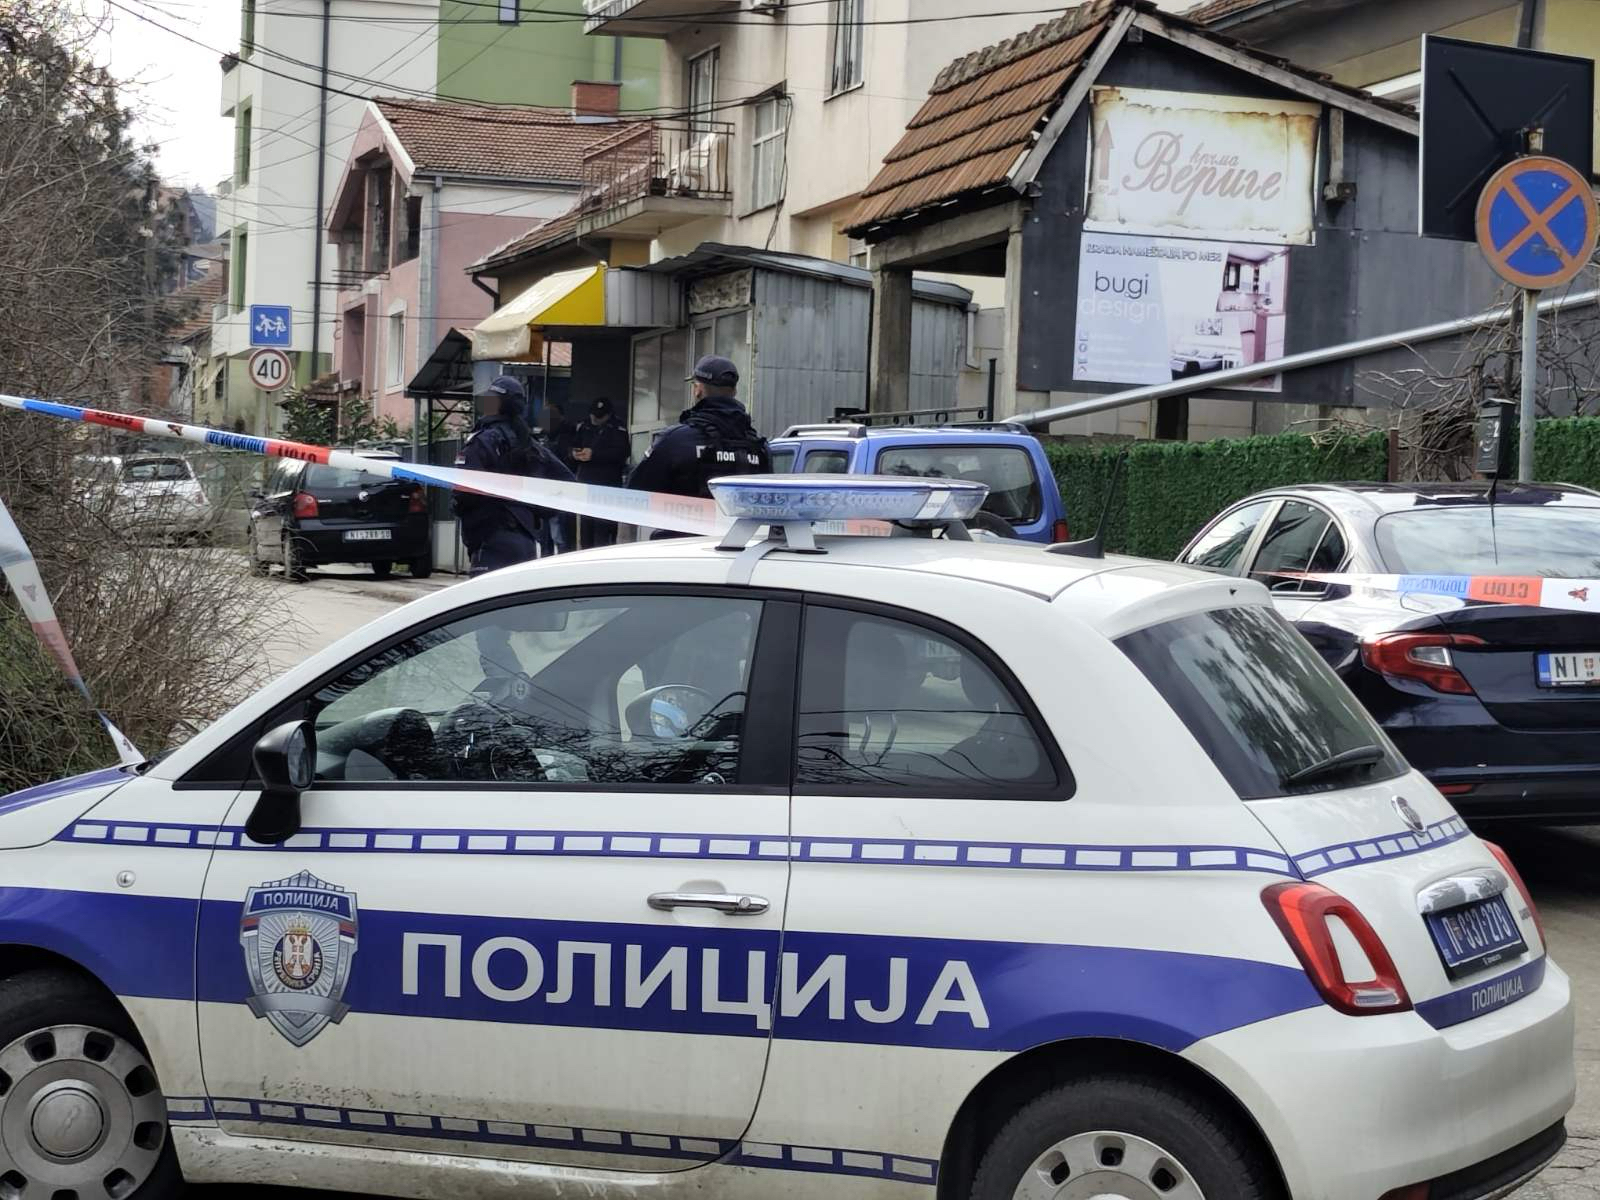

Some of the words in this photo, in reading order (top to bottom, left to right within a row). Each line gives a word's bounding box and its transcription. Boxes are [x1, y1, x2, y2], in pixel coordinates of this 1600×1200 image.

[1122, 131, 1282, 216] Вериге
[1094, 270, 1149, 299] bugi
[1079, 288, 1161, 323] design
[257, 359, 281, 379] 40
[263, 892, 340, 910] ПОЛИЦИЈА
[402, 932, 990, 1030] ПОЛИЦИЈА
[1471, 975, 1524, 1011] ПОЛИЦИЈА
